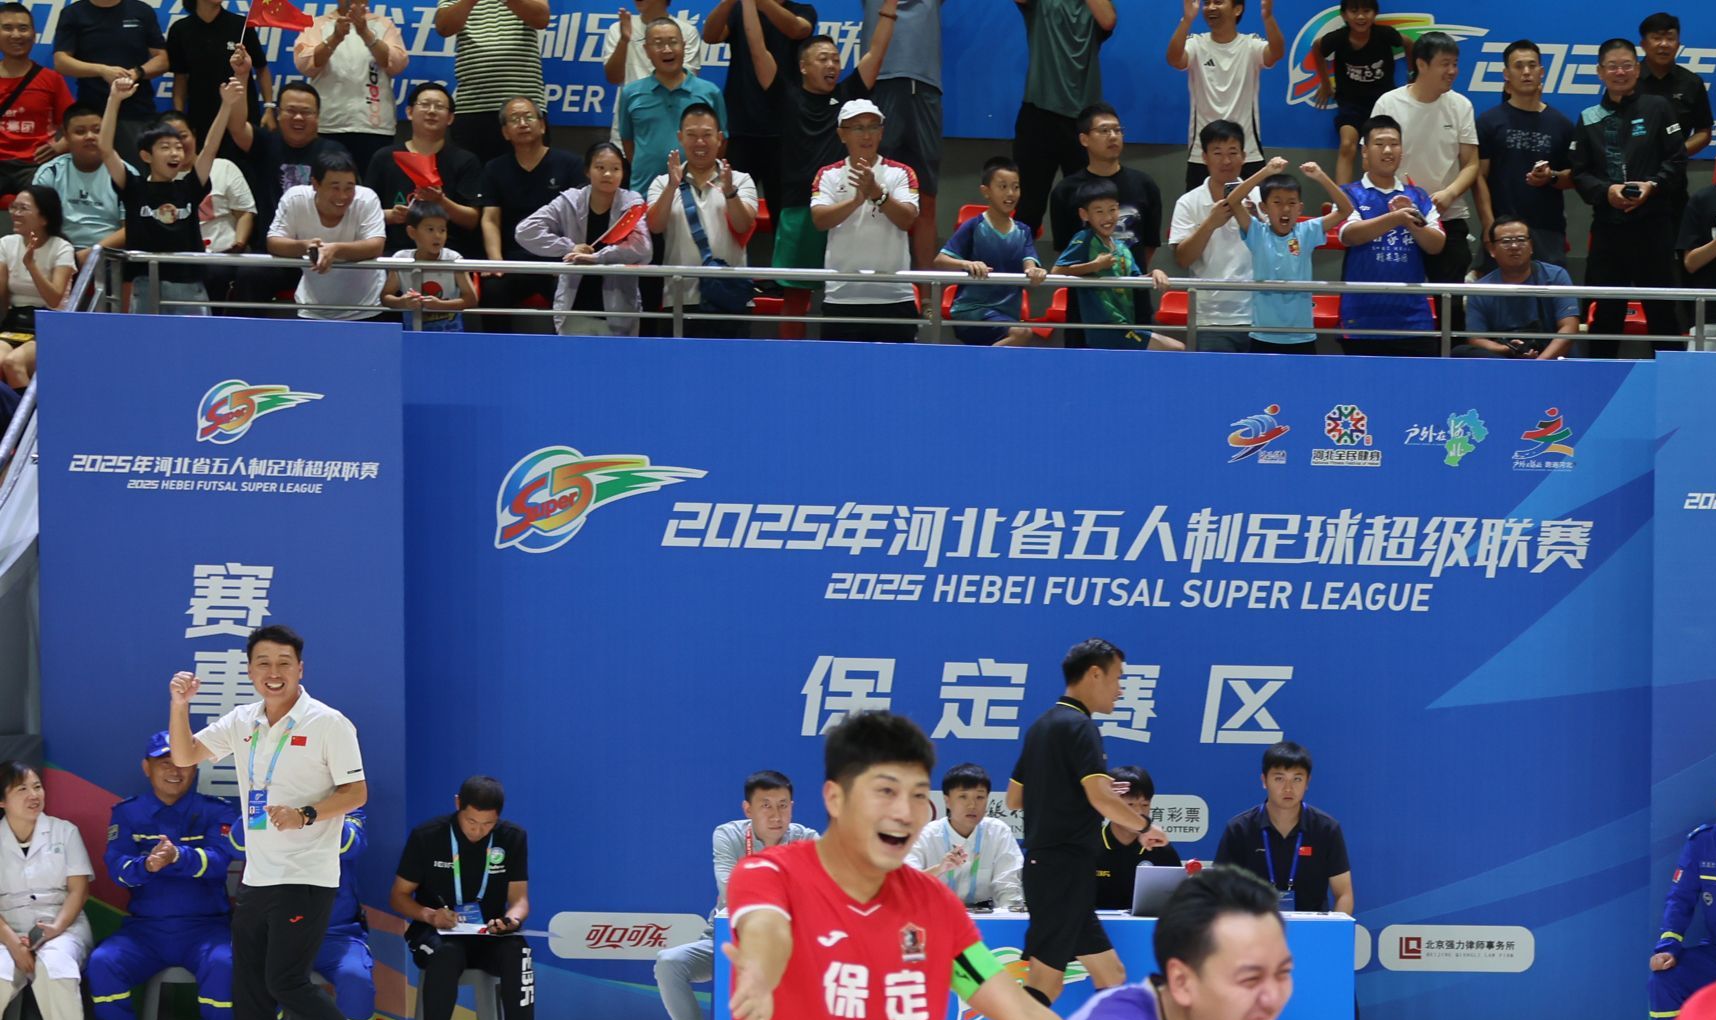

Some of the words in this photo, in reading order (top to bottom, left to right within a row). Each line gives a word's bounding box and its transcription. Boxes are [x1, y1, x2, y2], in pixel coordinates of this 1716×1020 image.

[69, 454, 380, 481] 2025年河北省五人制足球超级联赛
[127, 480, 159, 490] 2025
[161, 480, 194, 491] HEBEI
[196, 481, 239, 492] FUTSAL
[241, 482, 278, 493] SUPER
[279, 483, 323, 494] LEAGUE
[502, 475, 580, 541] Super
[661, 501, 1594, 578] 2025年河北省五人制足球超级联赛
[824, 573, 926, 601] 2025
[933, 575, 1036, 604] HEBEI
[1043, 576, 1172, 608] FUTSAL
[1180, 580, 1293, 610] SUPER
[1300, 582, 1433, 612] LEAGUE
[1151, 805, 1201, 823] 育彩票
[1425, 940, 1516, 951] 北京强力律师事务所
